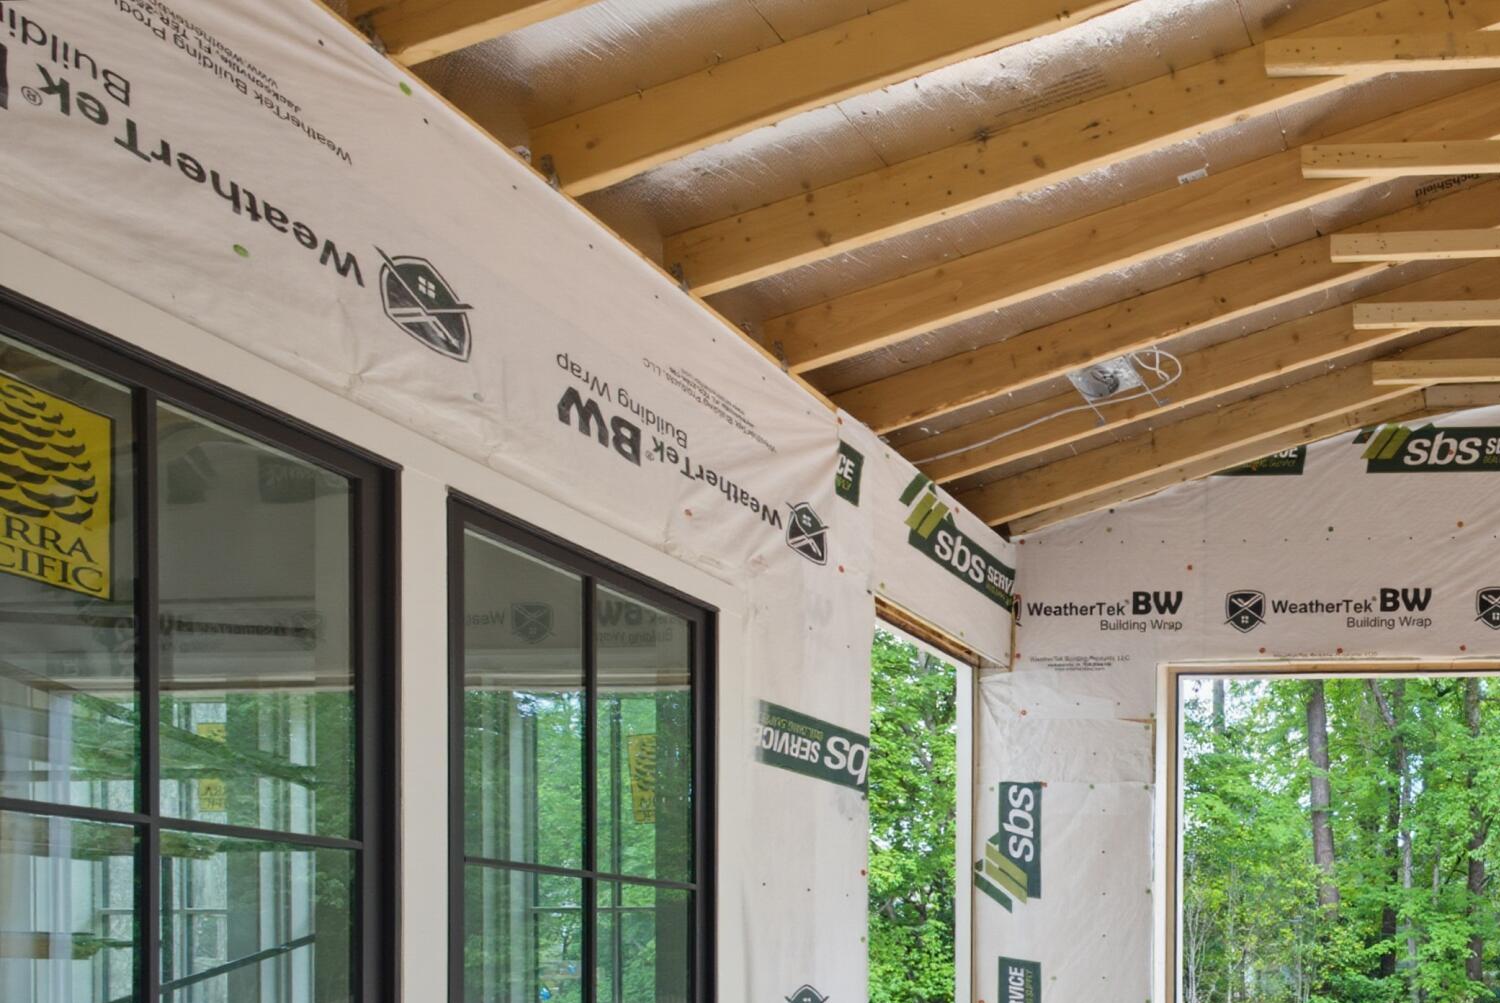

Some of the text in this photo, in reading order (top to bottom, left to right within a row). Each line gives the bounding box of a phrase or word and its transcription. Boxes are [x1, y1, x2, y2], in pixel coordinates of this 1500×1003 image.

[113, 0, 353, 165] WeatherTek Building Prod
[556, 352, 612, 402] Wrap
[556, 386, 642, 468] BW
[617, 387, 688, 449] Building
[1403, 431, 1484, 466] sbs
[934, 529, 987, 584] sbs
[1132, 590, 1183, 615] BW
[1379, 588, 1433, 612] BW
[1099, 619, 1183, 633] Building Wrap
[1346, 616, 1432, 630] Building Wrap
[757, 724, 821, 764] SERVIC
[1002, 784, 1035, 863] sbs
